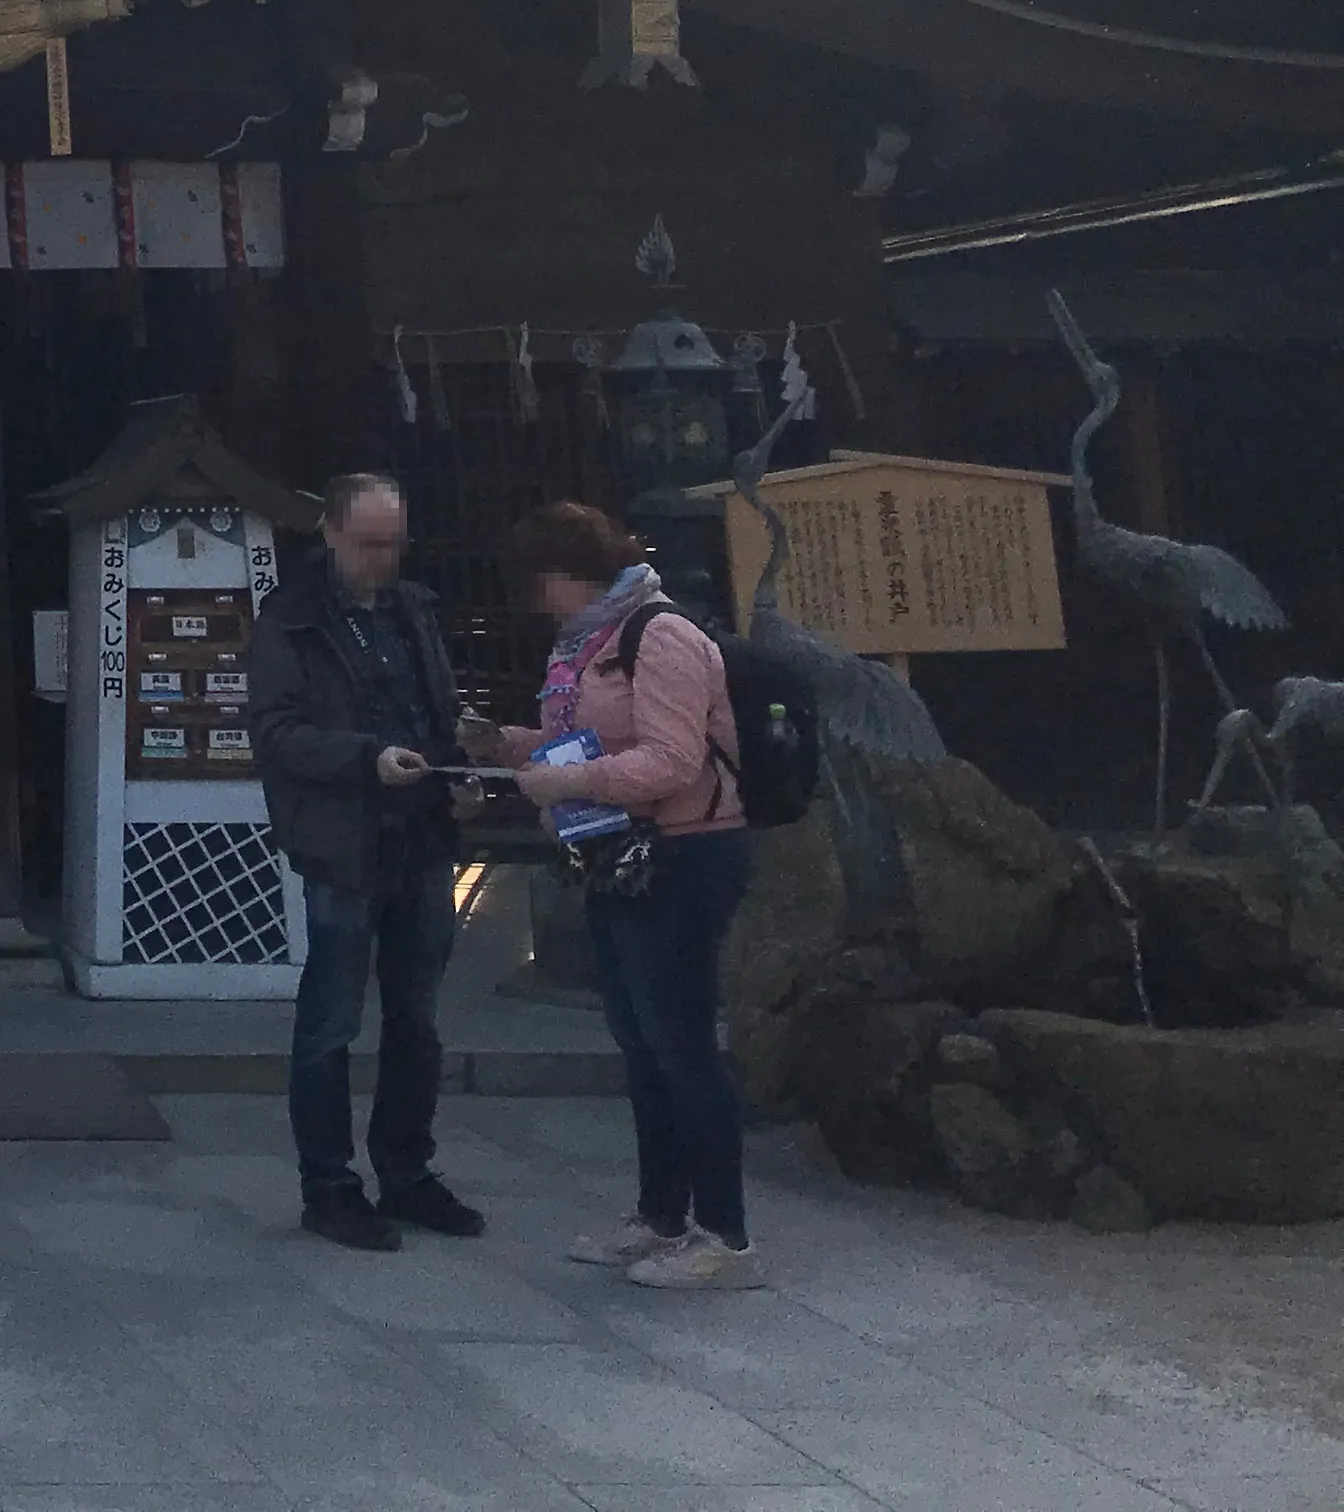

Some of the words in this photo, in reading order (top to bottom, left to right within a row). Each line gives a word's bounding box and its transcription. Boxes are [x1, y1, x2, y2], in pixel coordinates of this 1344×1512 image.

[102, 547, 125, 699] おみくじ100円
[346, 617, 368, 648] SONY
